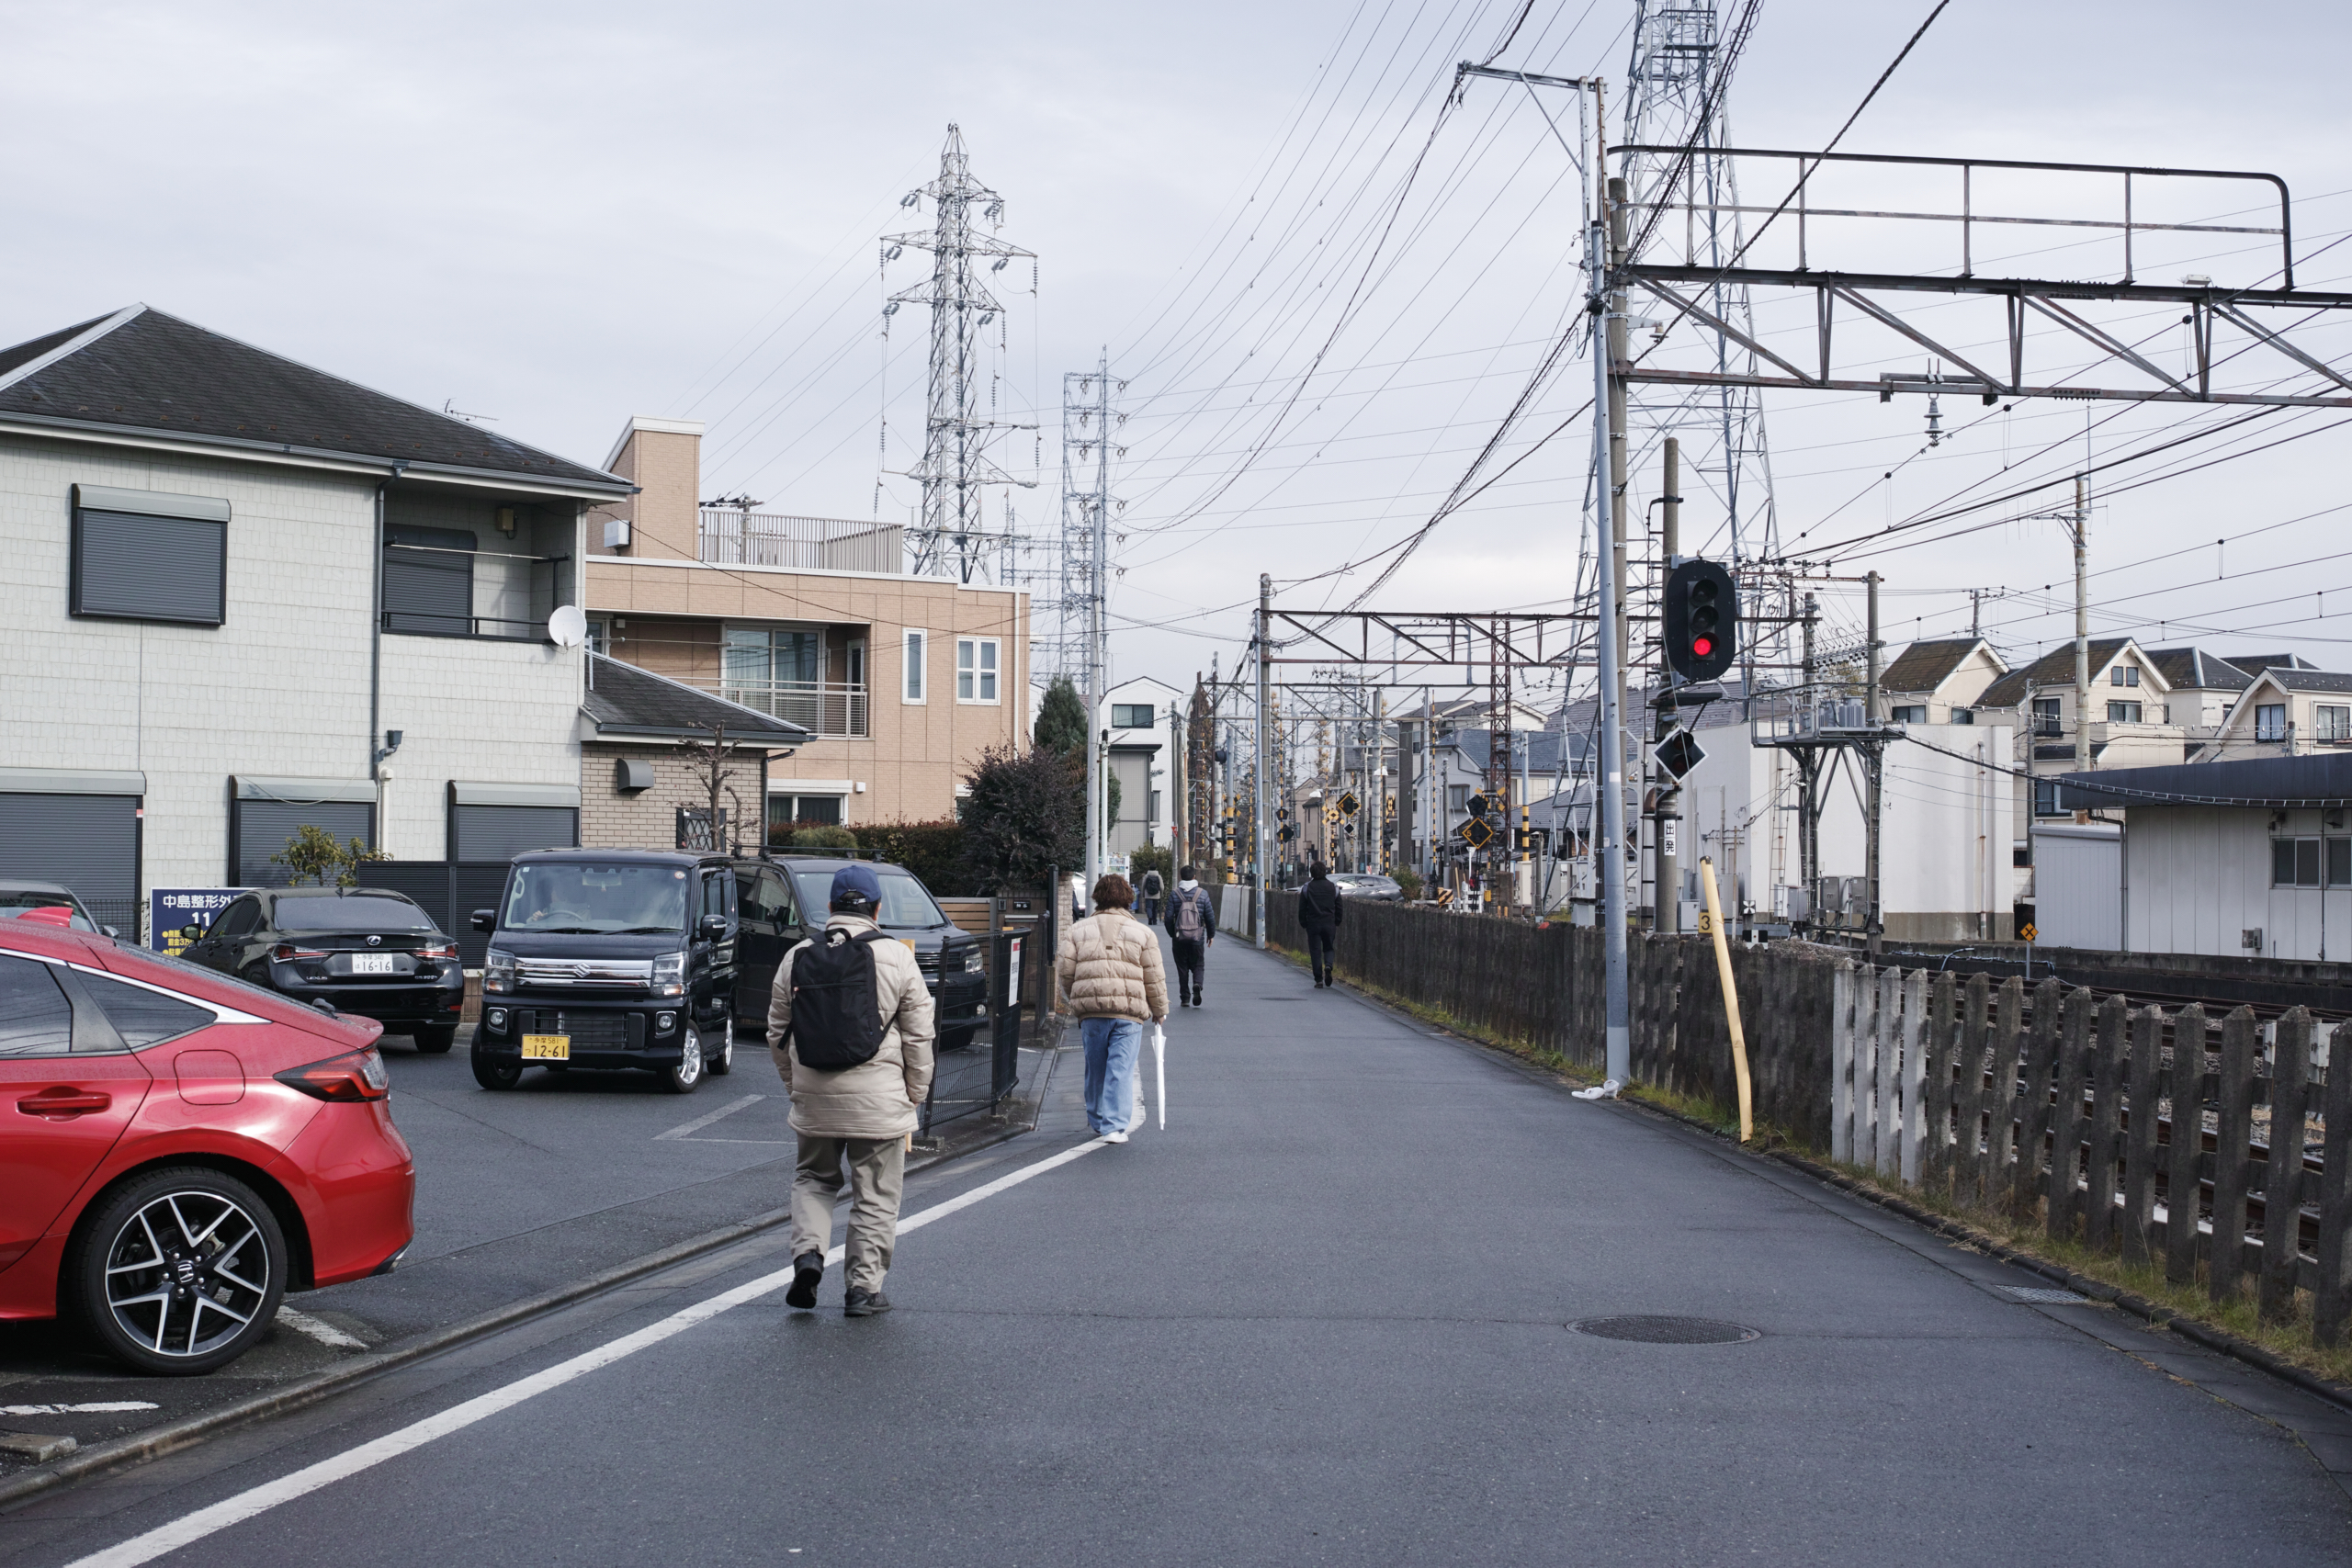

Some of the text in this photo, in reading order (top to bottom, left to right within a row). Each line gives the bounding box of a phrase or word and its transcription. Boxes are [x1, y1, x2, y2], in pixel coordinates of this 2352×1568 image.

[1466, 829, 1472, 838] 5
[1666, 823, 1675, 852] 出発
[363, 961, 390, 972] 16-16
[535, 1045, 565, 1057] 12-61
